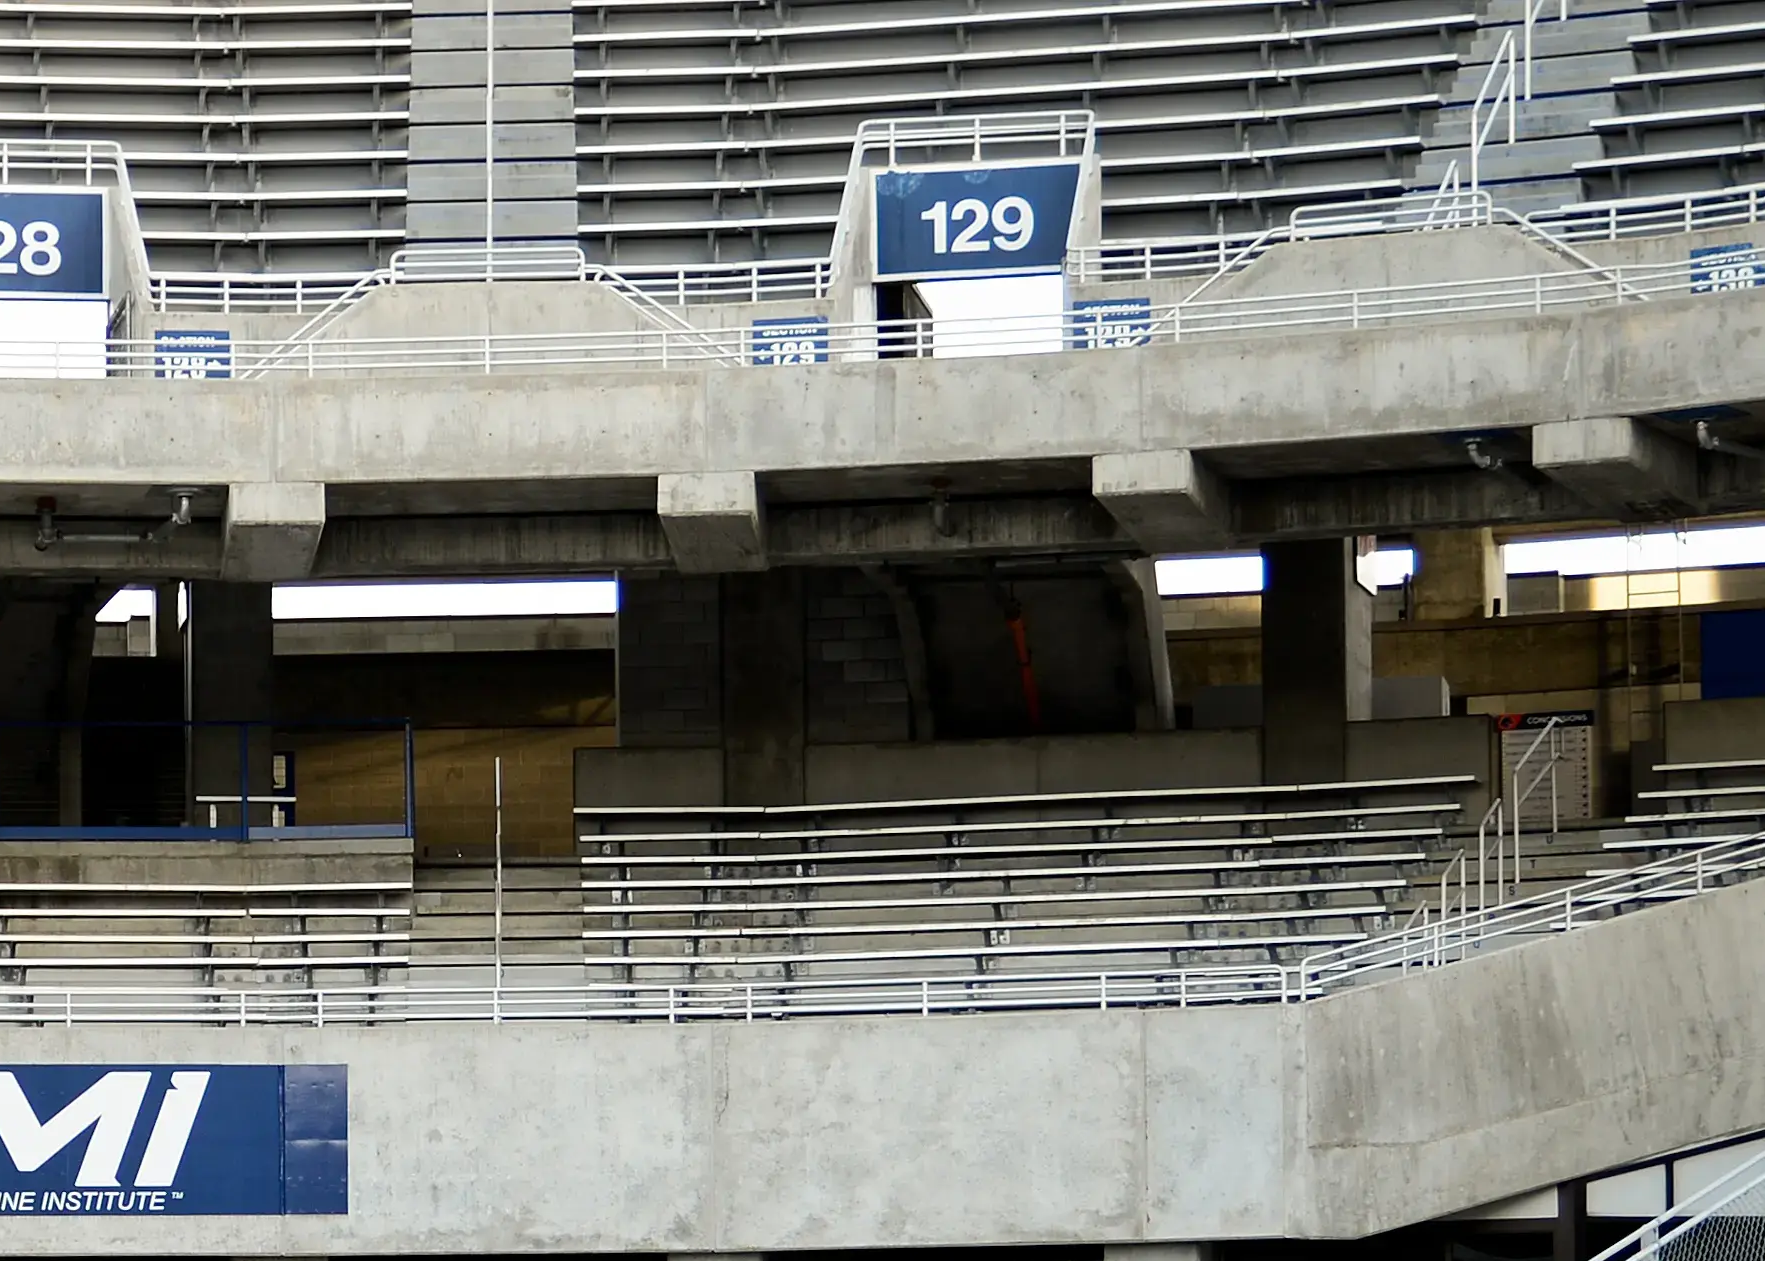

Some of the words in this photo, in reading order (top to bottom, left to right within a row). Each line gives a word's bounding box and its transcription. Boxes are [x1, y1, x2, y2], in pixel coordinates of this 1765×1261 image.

[920, 195, 1035, 254] 129
[769, 340, 815, 366] 129
[161, 356, 206, 379] 128
